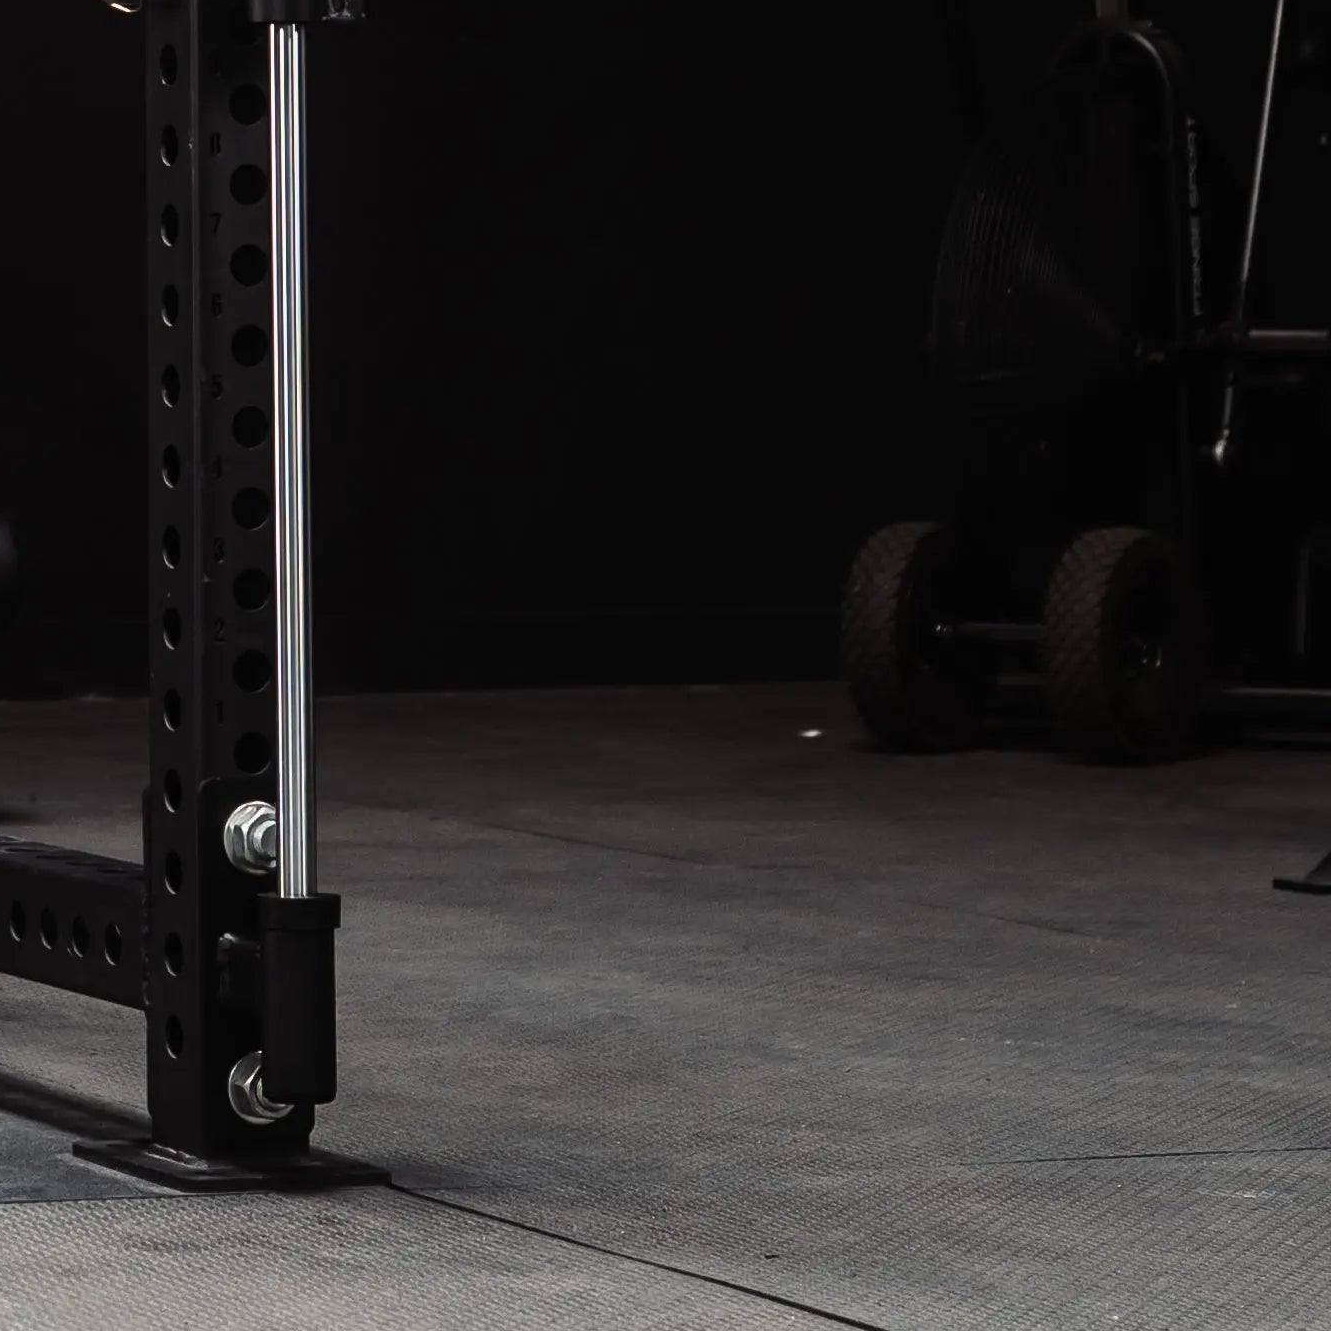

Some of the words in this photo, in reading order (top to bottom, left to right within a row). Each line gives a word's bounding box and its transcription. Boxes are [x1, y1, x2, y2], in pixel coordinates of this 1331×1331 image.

[210, 213, 222, 236] 7
[211, 294, 222, 316] 6
[212, 376, 223, 398] 5
[213, 538, 225, 562] 3
[214, 618, 226, 642] 2
